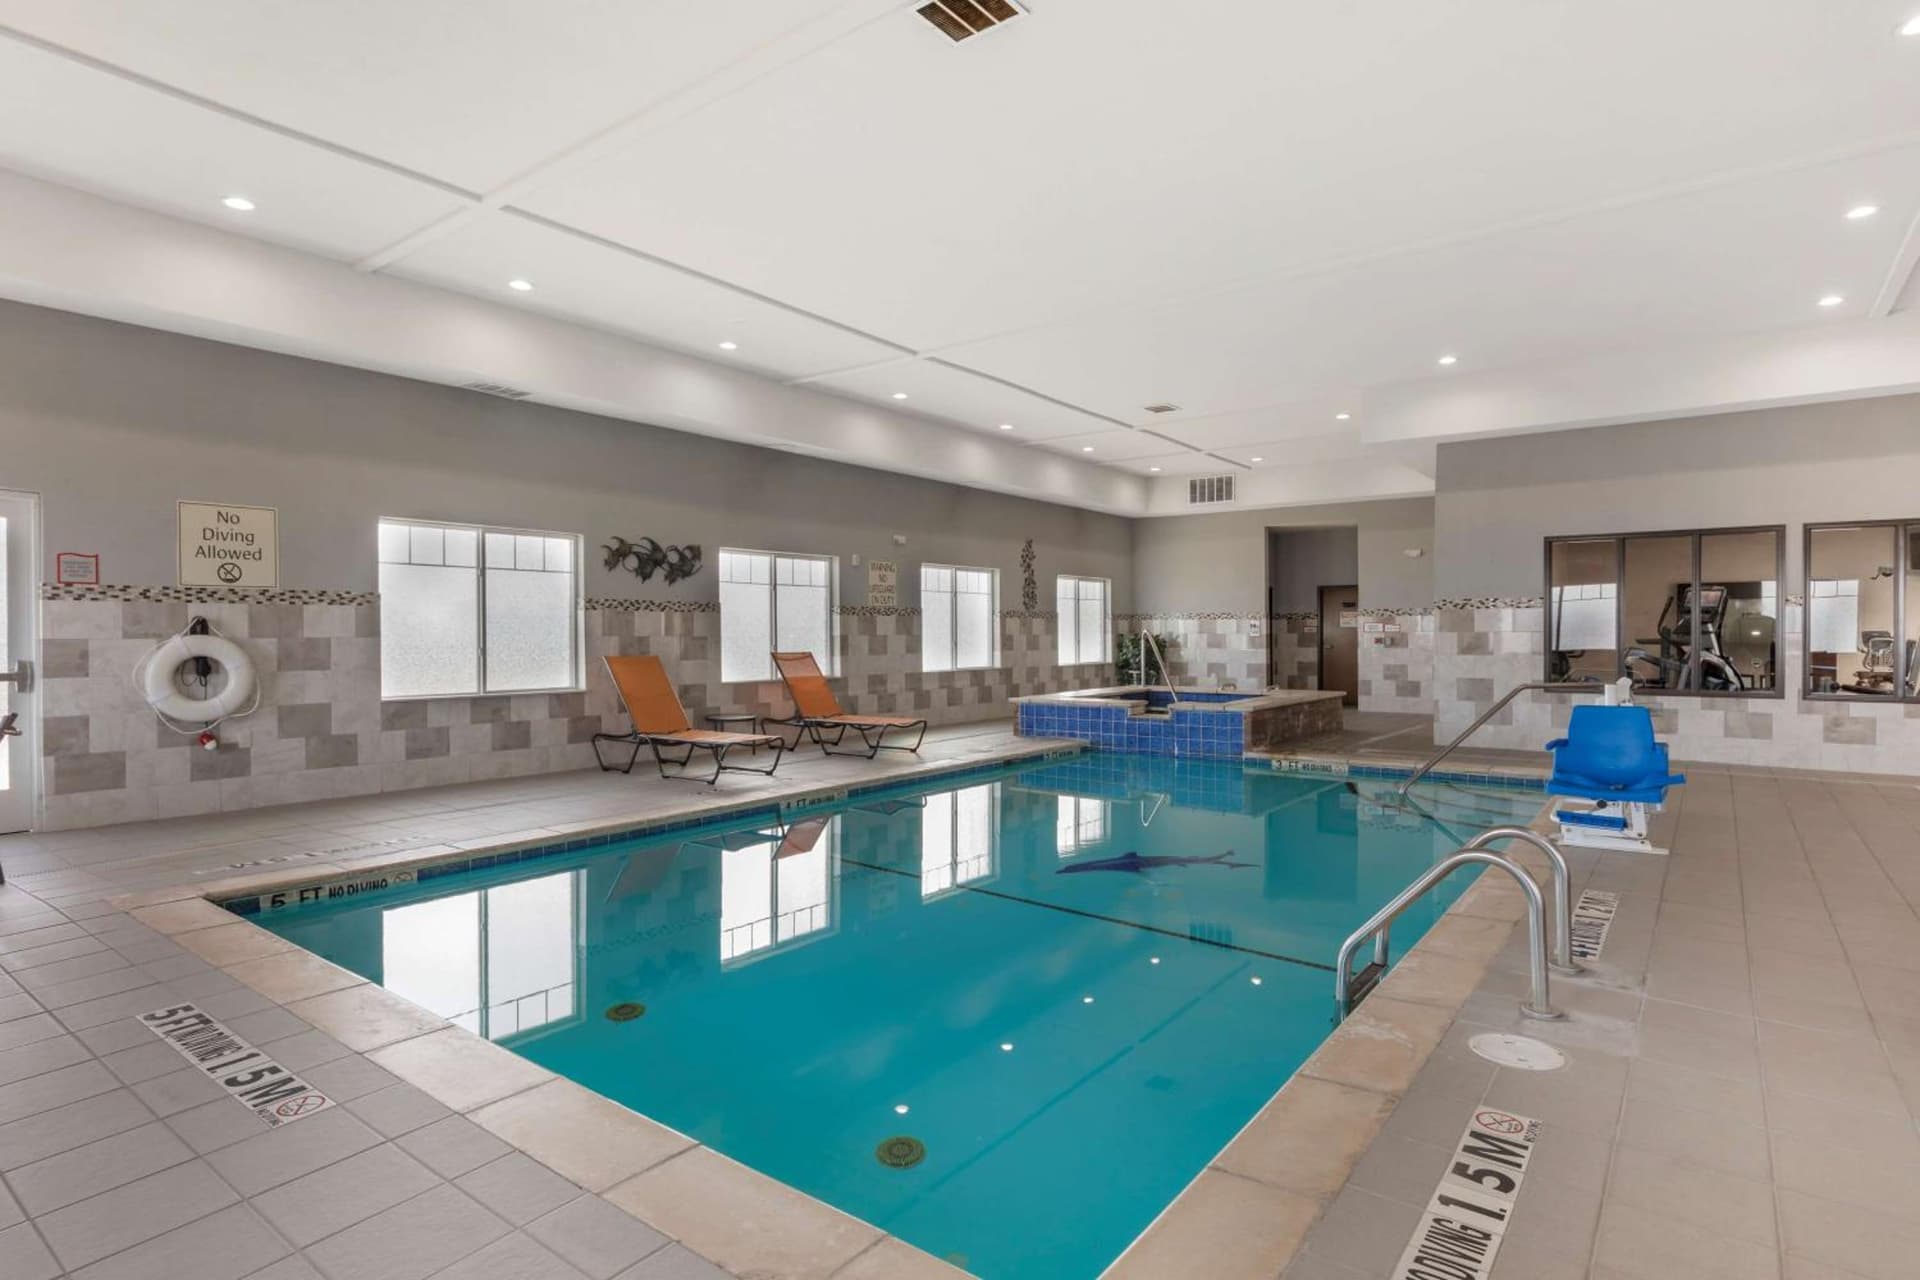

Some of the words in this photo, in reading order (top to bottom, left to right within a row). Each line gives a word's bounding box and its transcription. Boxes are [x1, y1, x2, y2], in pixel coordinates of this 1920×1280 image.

[217, 510, 240, 525] No
[202, 527, 255, 545] Diving
[195, 545, 263, 561] Allowed
[270, 892, 287, 908] 5
[300, 886, 322, 902] FT
[328, 886, 344, 899] NO
[349, 878, 388, 896] DIVING
[1437, 1129, 1530, 1222] 1.5M
